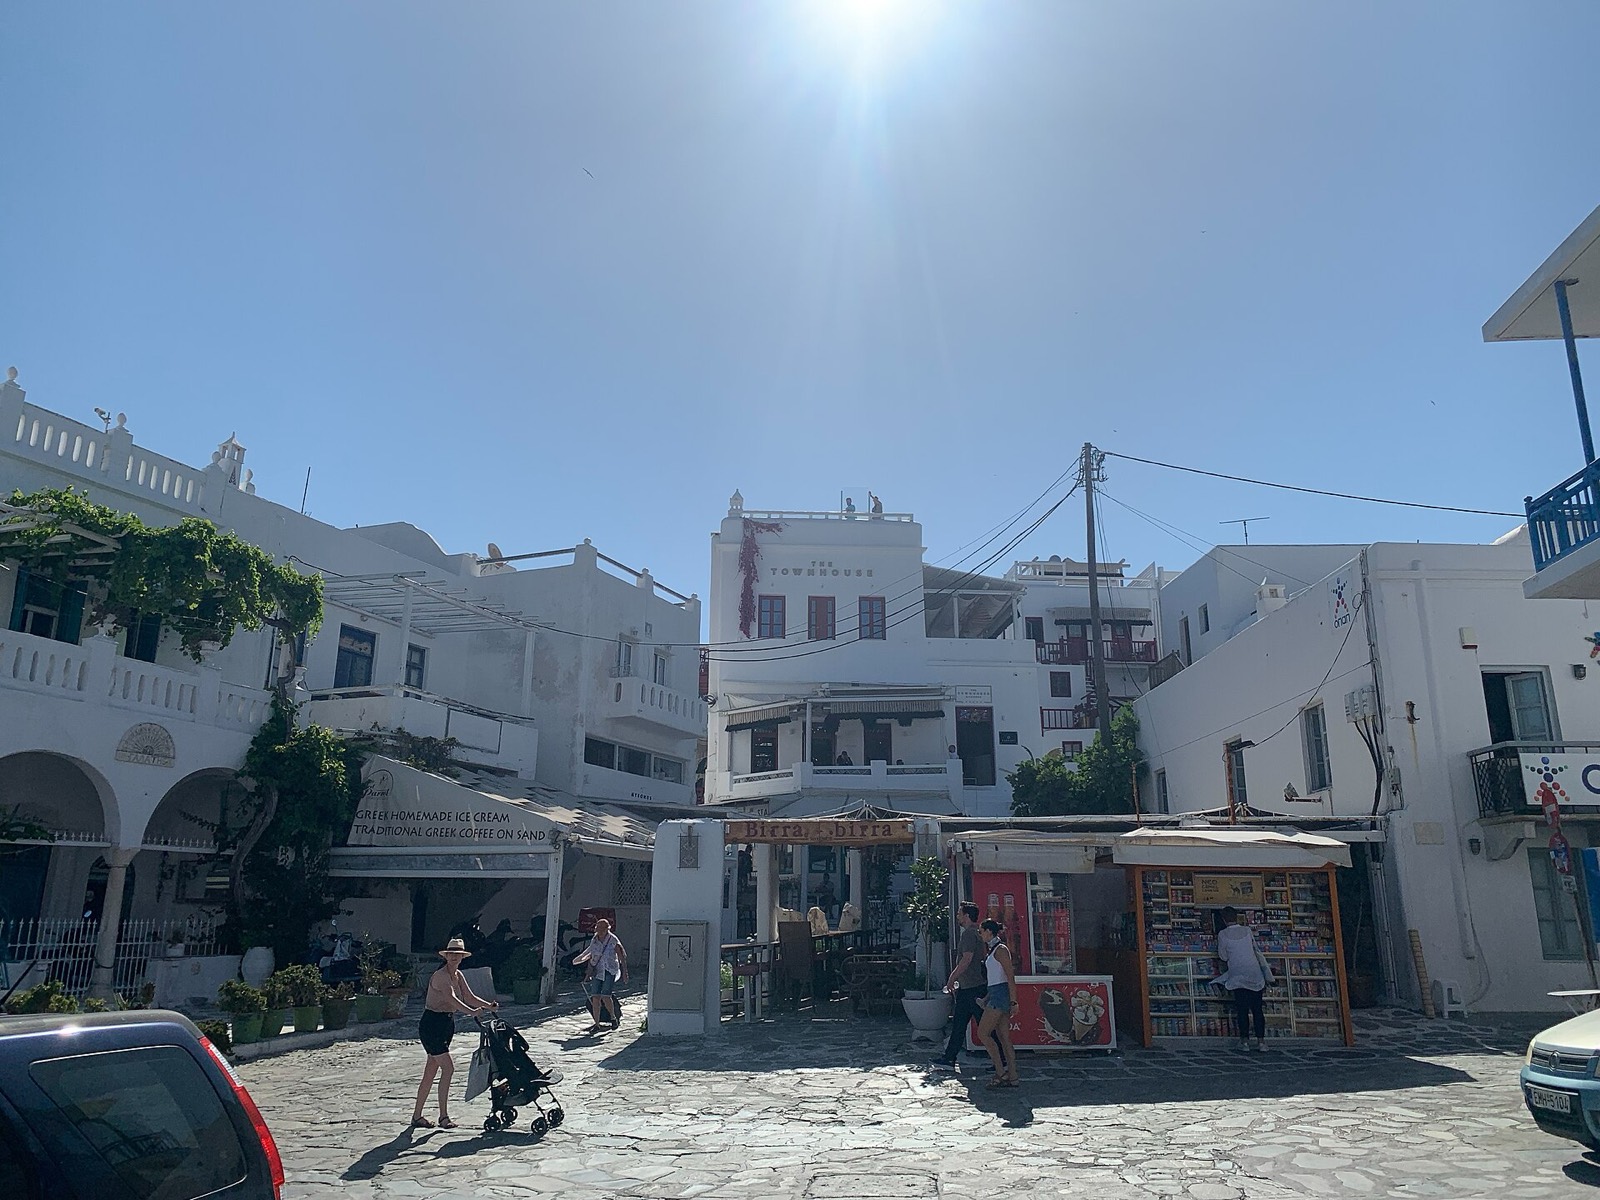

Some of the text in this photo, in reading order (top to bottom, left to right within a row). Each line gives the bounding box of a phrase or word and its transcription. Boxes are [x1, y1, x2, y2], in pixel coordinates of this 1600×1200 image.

[770, 568, 873, 578] TOWNHOUSE
[355, 810, 510, 823] GREEK HOMEMADE ICE CREAM
[353, 824, 546, 841] TRADITIONAL GREEK COFFEE ON SAND
[745, 821, 804, 838] Birra
[834, 822, 894, 838] birra
